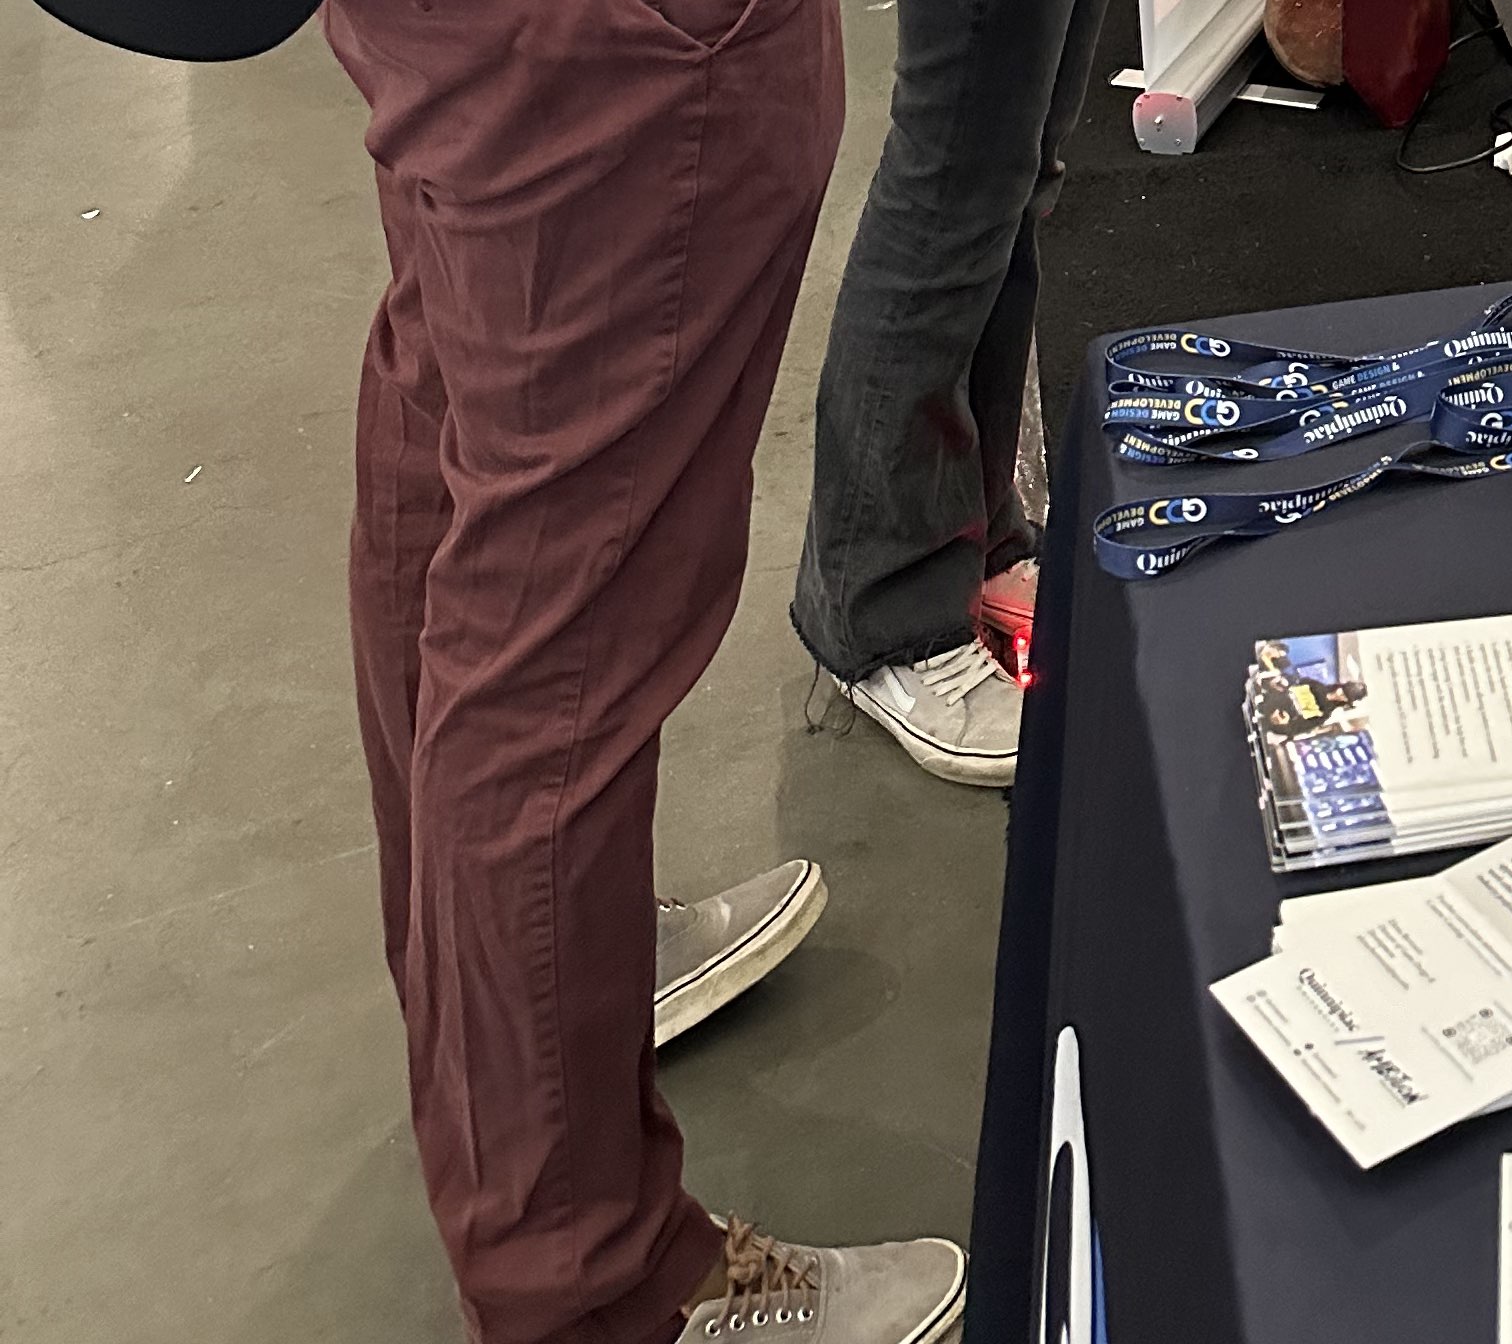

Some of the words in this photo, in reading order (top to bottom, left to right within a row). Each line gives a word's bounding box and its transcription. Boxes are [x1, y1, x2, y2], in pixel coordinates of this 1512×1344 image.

[1331, 373, 1357, 391] GAME
[1150, 409, 1181, 422] GAME
[1304, 395, 1408, 445] Quinnipiac
